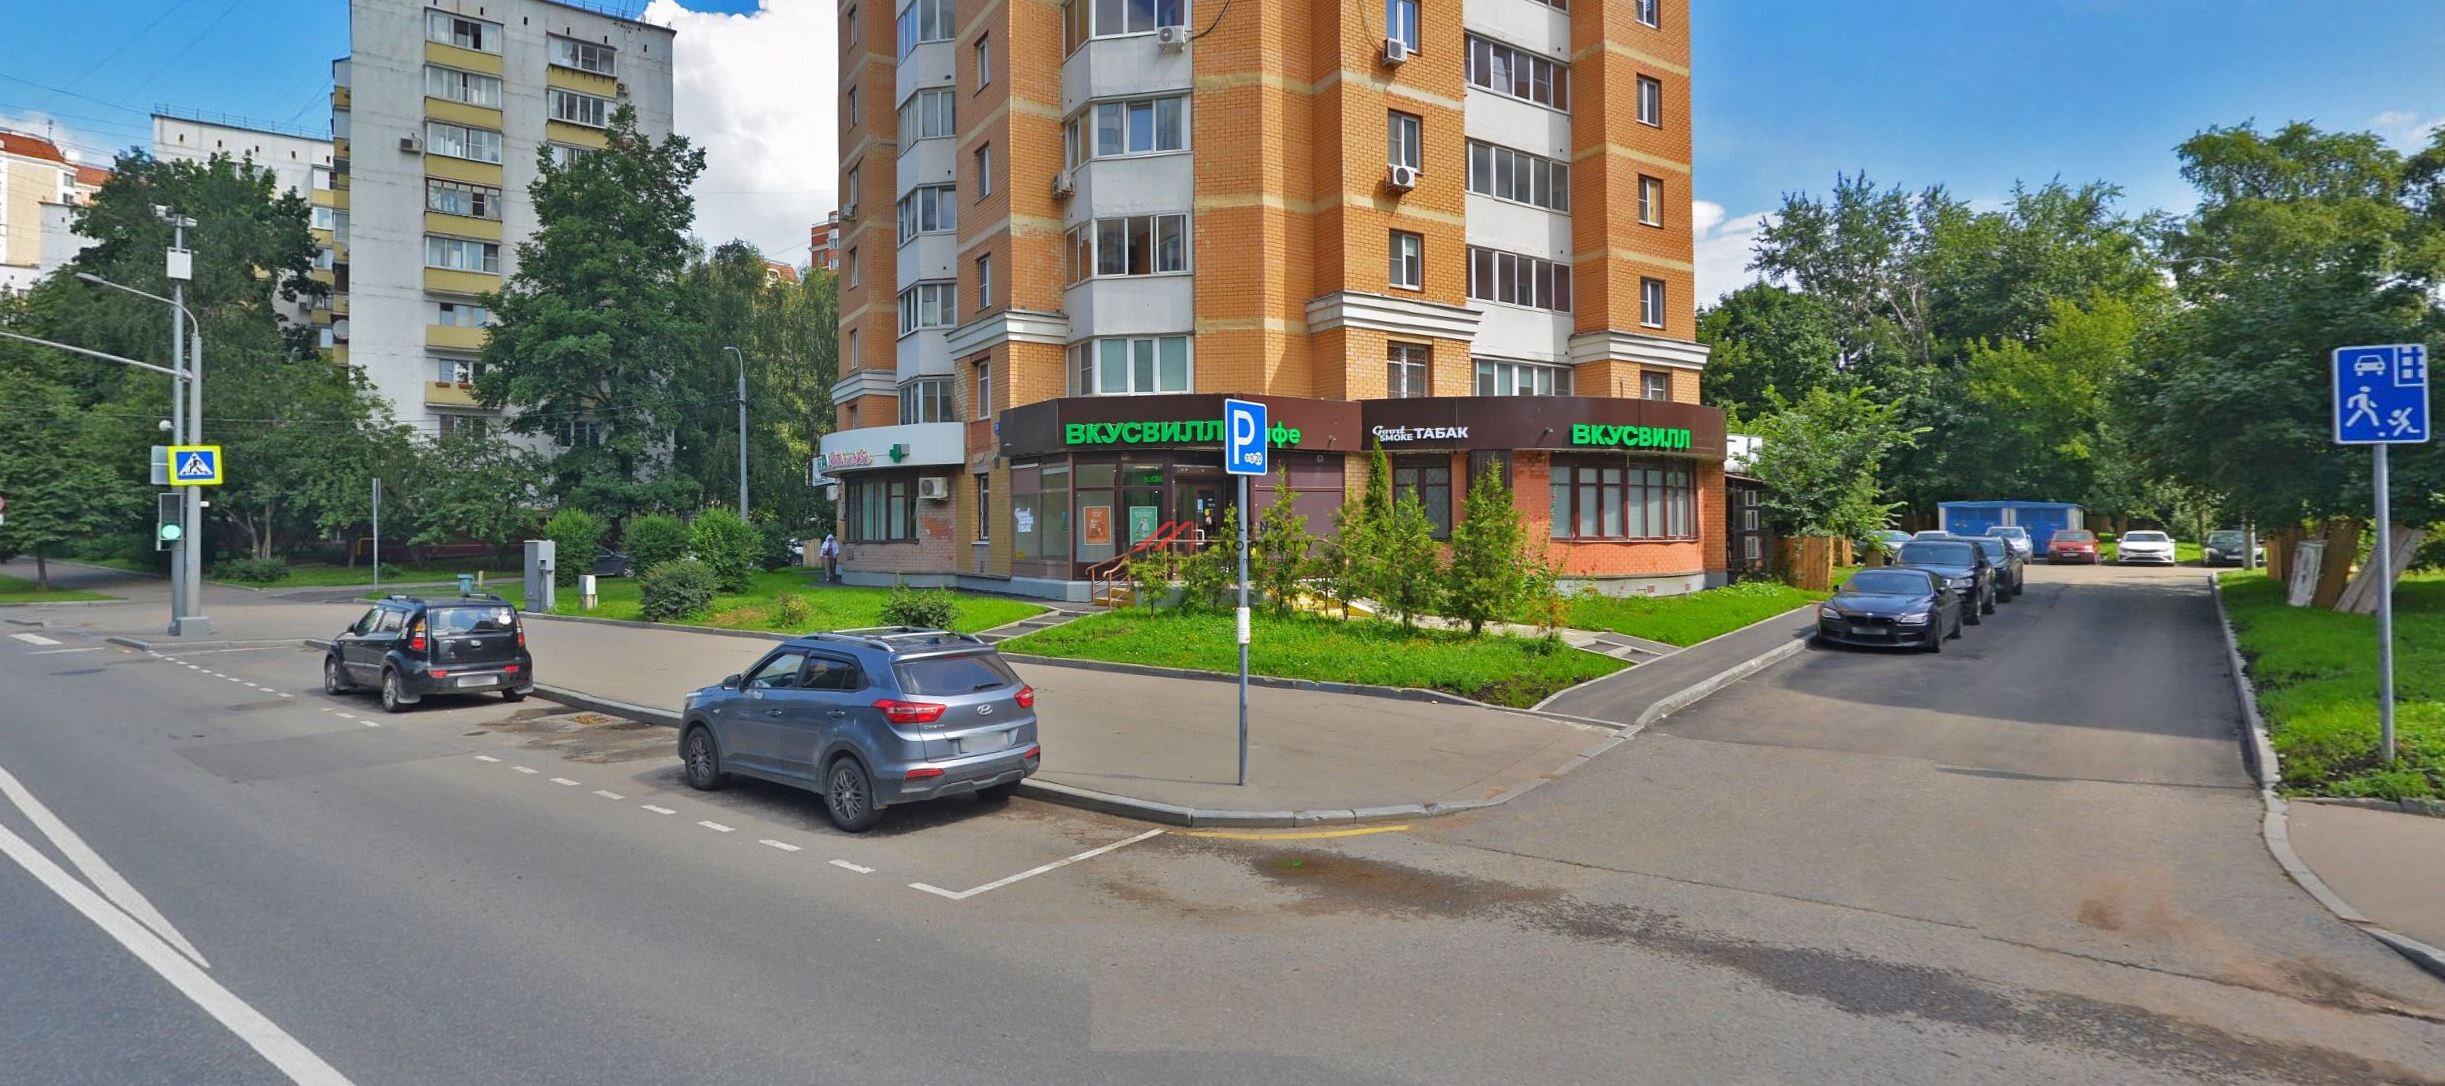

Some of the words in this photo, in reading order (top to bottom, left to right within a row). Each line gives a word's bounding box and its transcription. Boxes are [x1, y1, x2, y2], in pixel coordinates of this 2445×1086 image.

[1066, 420, 1224, 444] ВКУСВИЛЛ
[1267, 421, 1301, 448] фе
[1233, 409, 1255, 464] P
[1380, 433, 1413, 441] SMOKE
[1413, 426, 1469, 439] ТАБАК
[1572, 424, 1691, 448] ВКУСВИЛЛ
